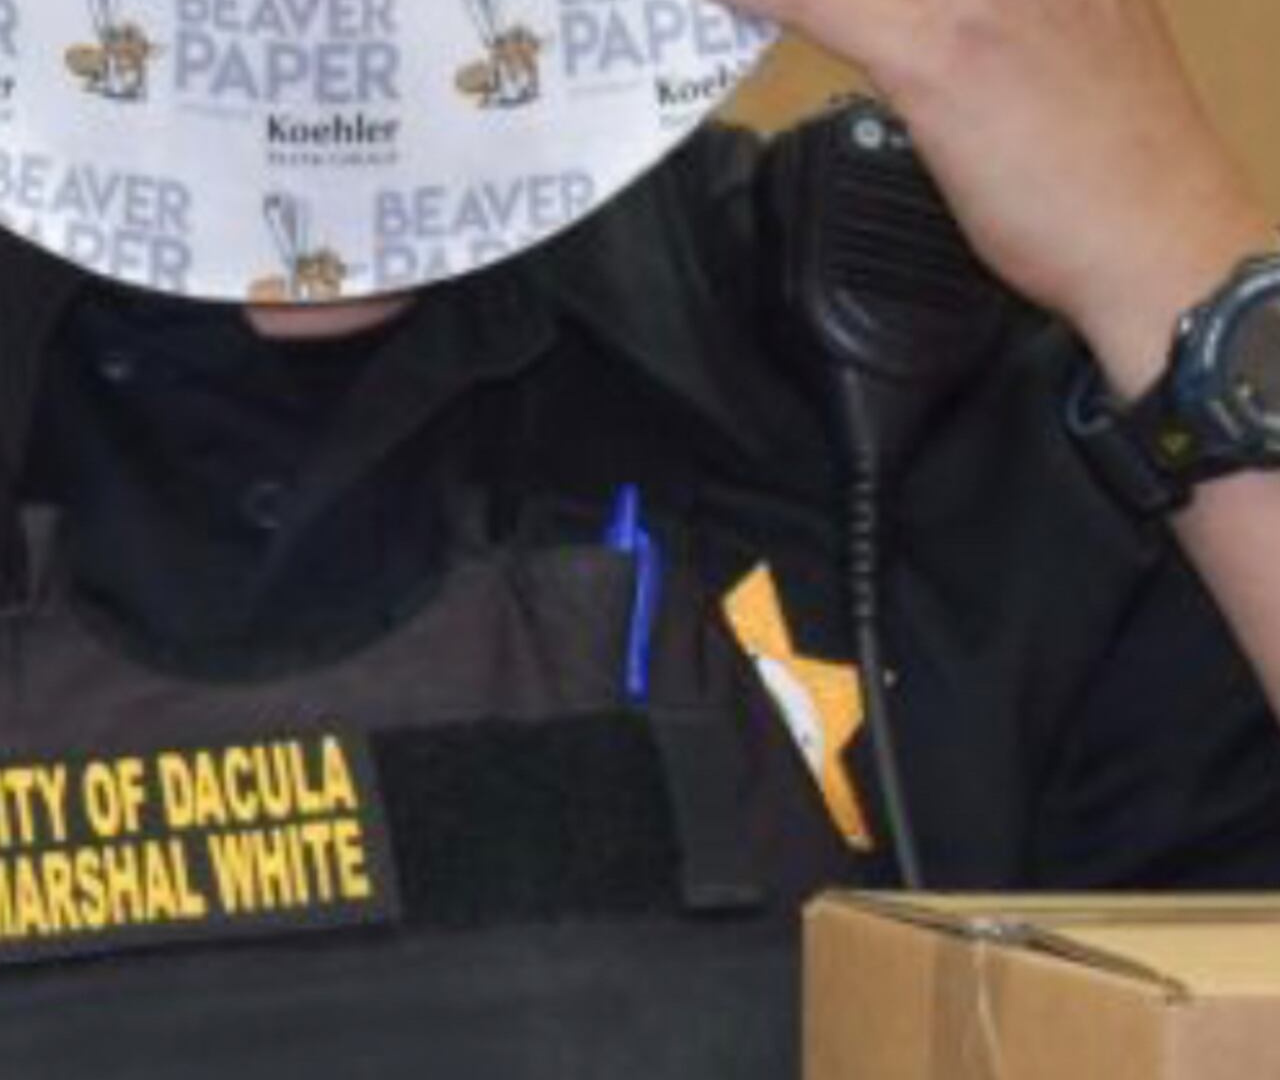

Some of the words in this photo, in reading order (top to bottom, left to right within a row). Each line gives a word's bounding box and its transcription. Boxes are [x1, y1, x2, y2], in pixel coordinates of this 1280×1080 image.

[174, 32, 401, 104] PAPER
[266, 111, 400, 144] Koehler
[375, 170, 595, 238] BEAVER
[82, 758, 145, 836] OF
[157, 735, 356, 826] DACULA
[210, 818, 372, 913] WHITE
